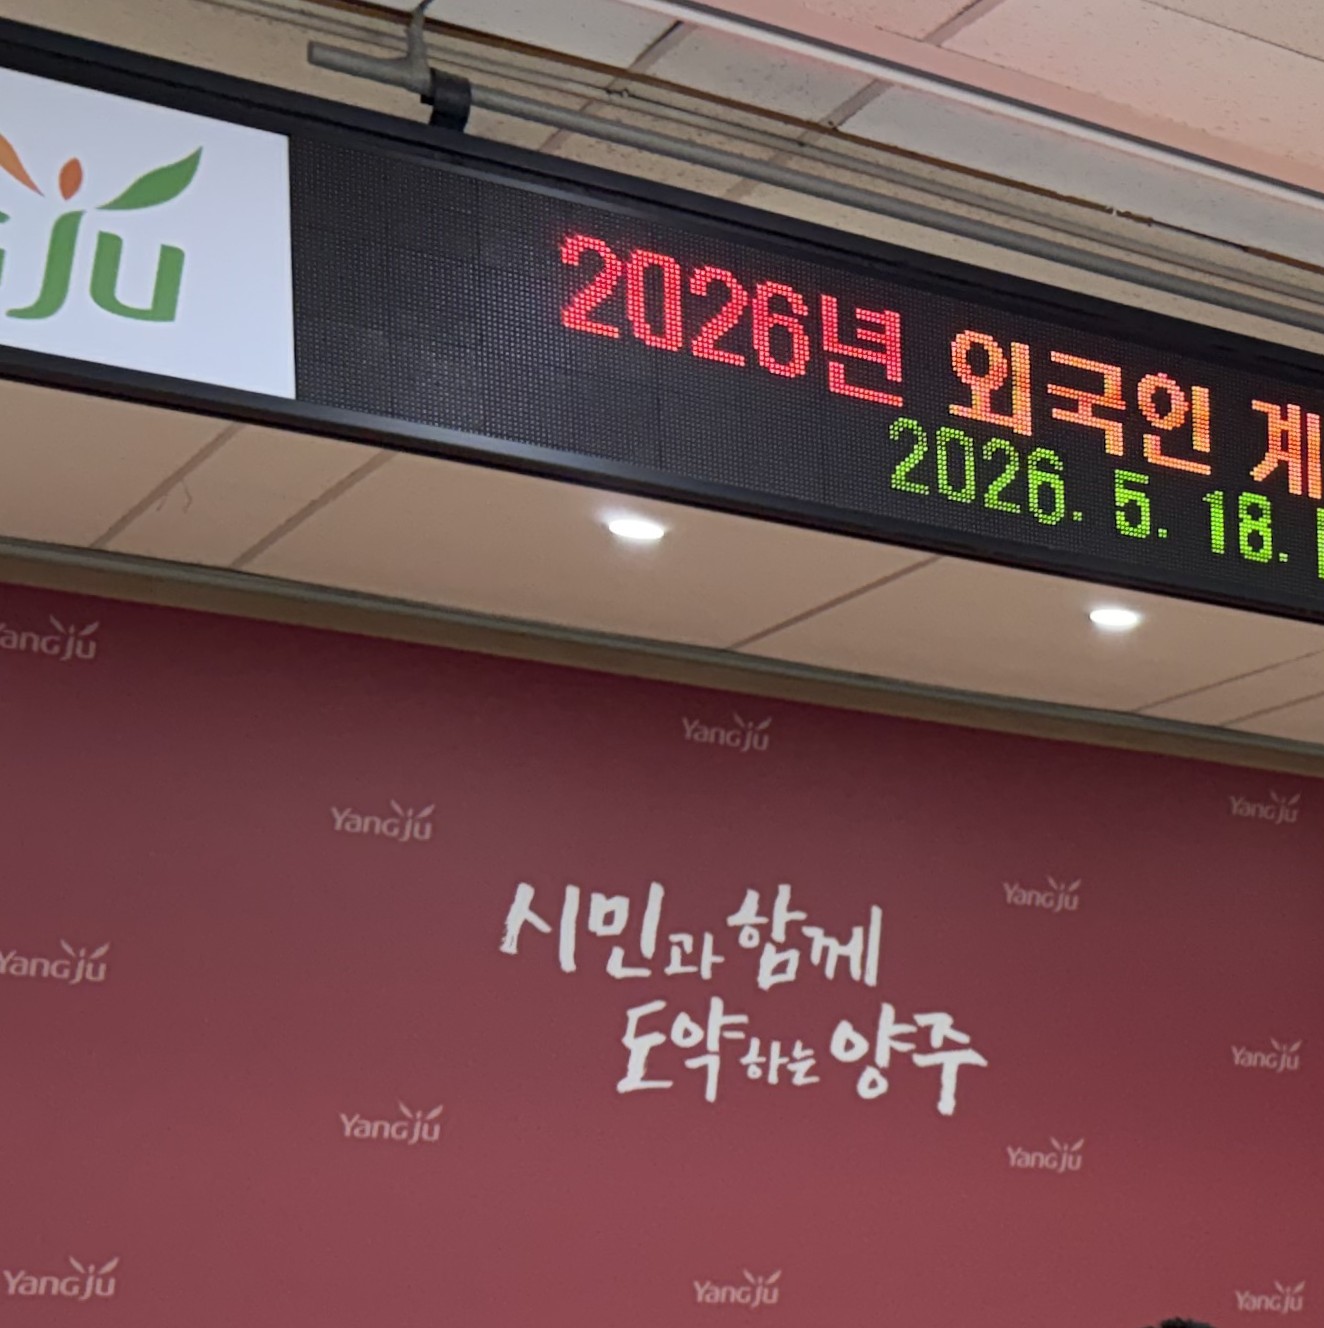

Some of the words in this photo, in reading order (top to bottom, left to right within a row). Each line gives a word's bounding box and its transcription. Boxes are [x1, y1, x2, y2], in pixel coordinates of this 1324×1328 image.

[557, 232, 903, 407] 2026년
[950, 330, 1212, 476] 외국인
[888, 417, 1084, 525] 2026.
[1114, 469, 1168, 539] 5.
[1203, 490, 1289, 563] 18.
[682, 714, 770, 753] Yangju
[331, 805, 433, 842] Yangju
[1003, 880, 1079, 913] Yangju
[500, 882, 724, 980] 시민과
[726, 884, 883, 991] 함께
[616, 996, 820, 1103] 도약하는
[830, 1002, 988, 1116] 양주
[1232, 1043, 1299, 1073] Yangju
[340, 1110, 441, 1145] Yangju
[1007, 1143, 1082, 1174] Yangju
[3, 1265, 117, 1302] Yangju
[694, 1276, 779, 1309] Yangju
[1235, 1287, 1303, 1315] Yangju
